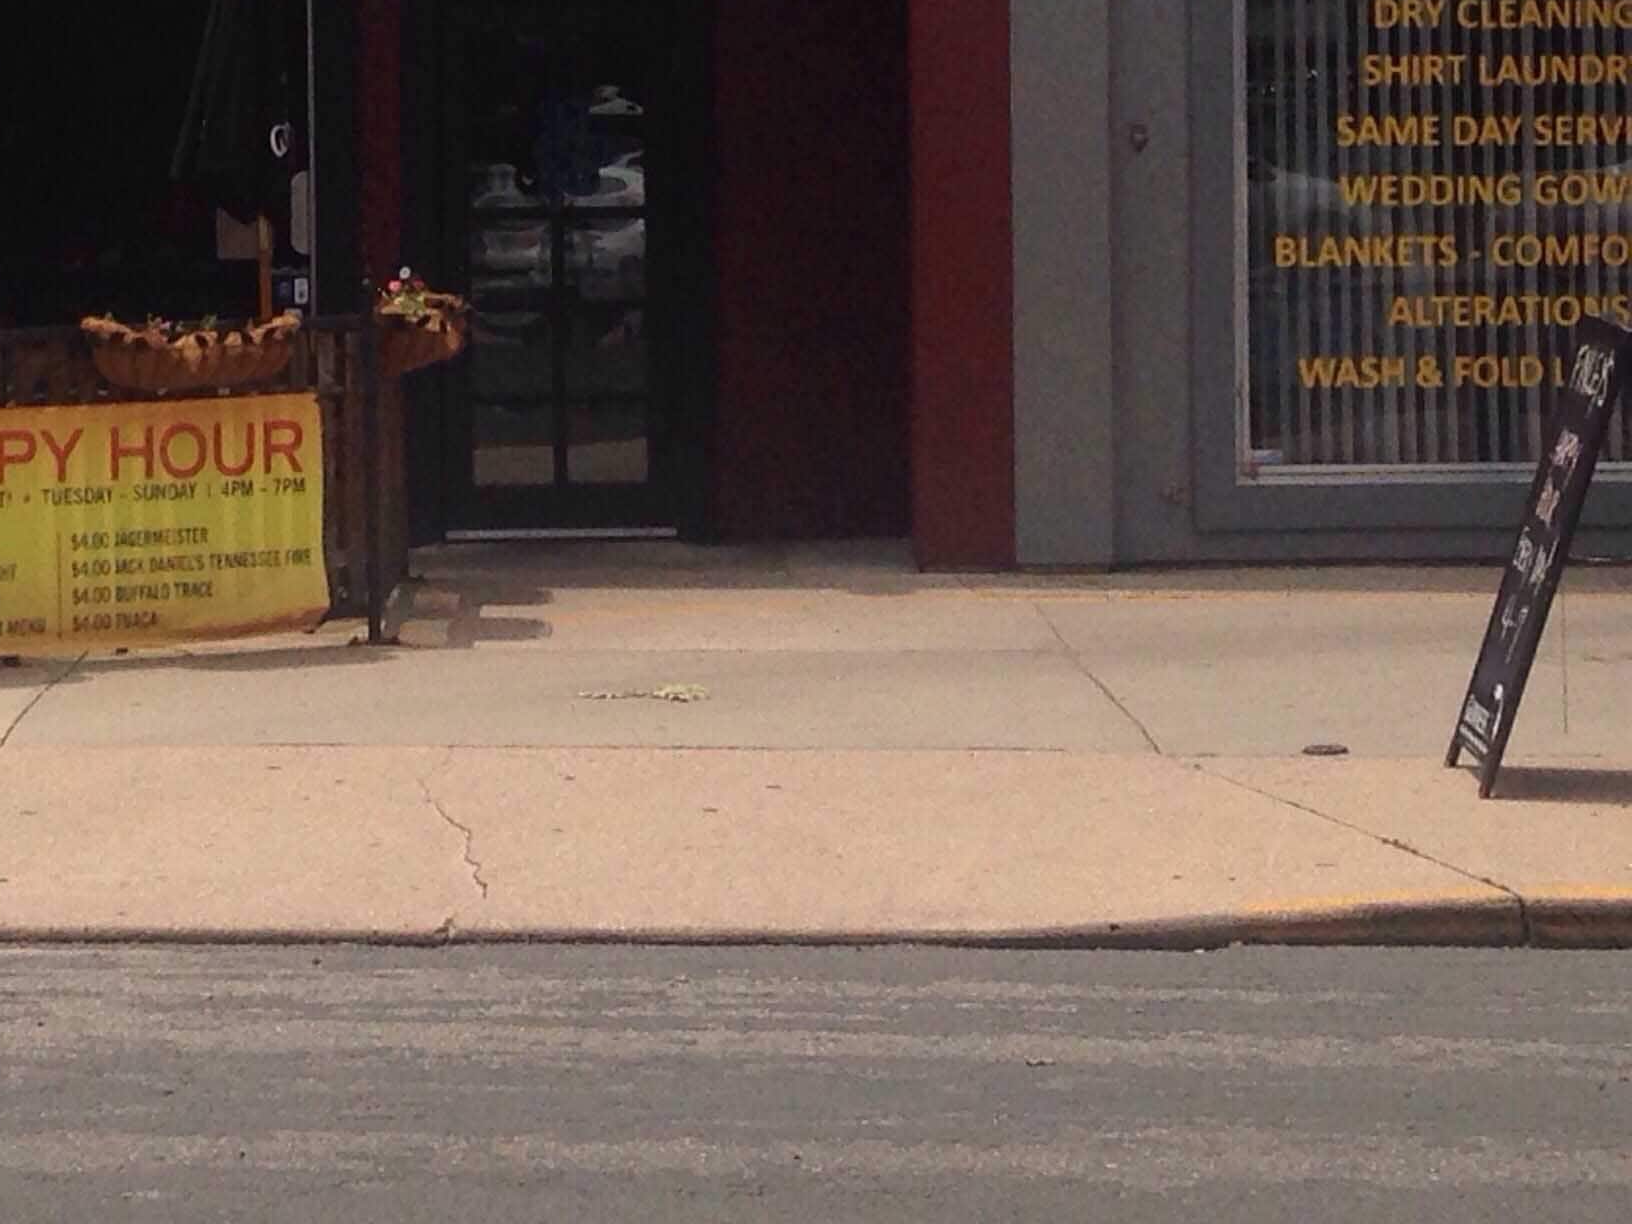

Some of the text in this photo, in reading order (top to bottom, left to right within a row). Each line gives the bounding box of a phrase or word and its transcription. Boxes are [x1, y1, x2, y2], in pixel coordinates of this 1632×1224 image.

[1363, 55, 1632, 86] SHIRT LAUNDR
[1336, 116, 1441, 147] SAME
[1454, 115, 1521, 146] DAY
[1340, 175, 1632, 206] WEDDING GOW
[1276, 235, 1457, 267] BLANKETS
[1491, 234, 1632, 267] COMFO
[1299, 356, 1404, 388] WASH
[1416, 356, 1443, 388] &
[1455, 356, 1543, 387] FOLD
[110, 420, 304, 481] HOUR
[41, 487, 112, 506] TUESDAY
[133, 482, 198, 502] SUNDAY
[221, 479, 254, 498] 4PM
[272, 477, 306, 496] 7PM
[114, 556, 144, 575] JACK
[209, 550, 280, 571] TENNESSEE
[114, 582, 170, 604] BUFFALO
[173, 579, 214, 599] TRACE
